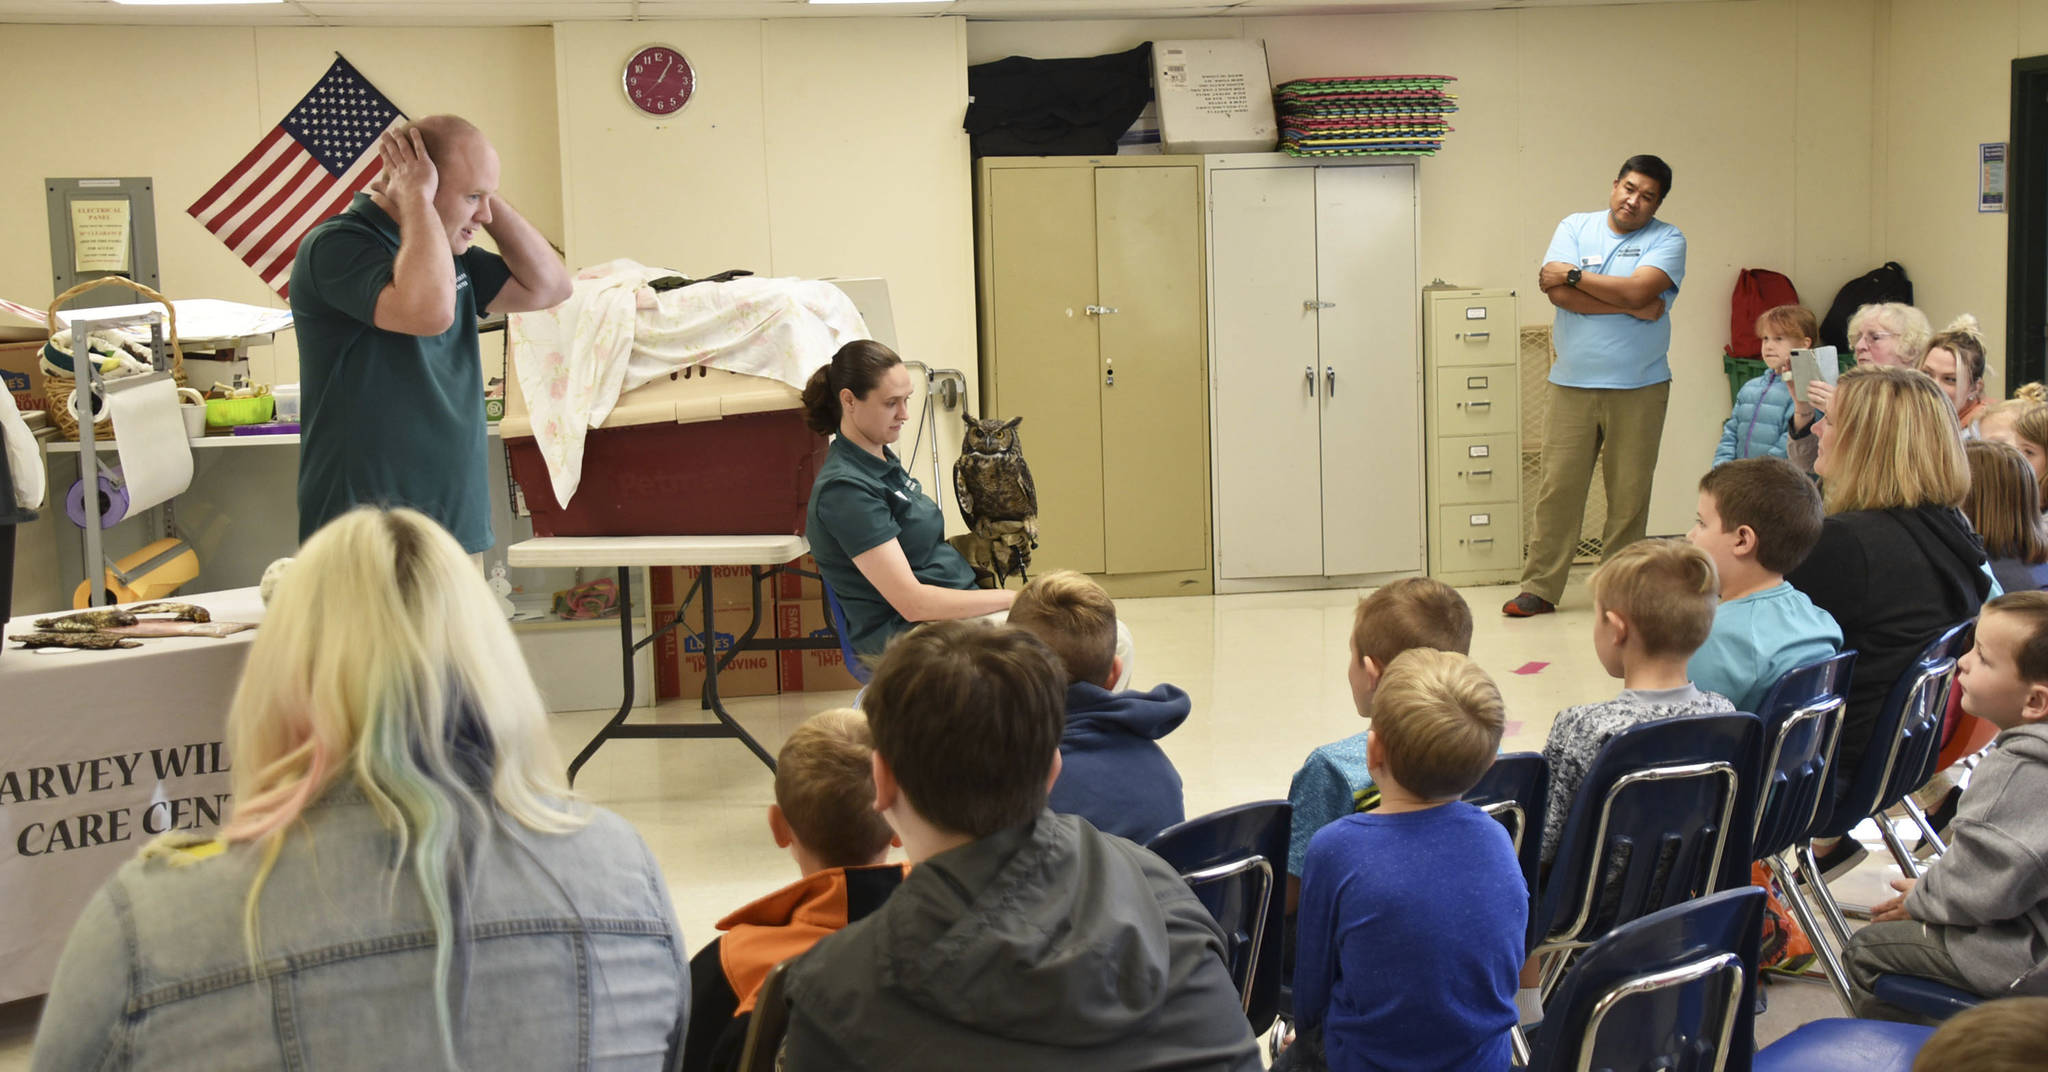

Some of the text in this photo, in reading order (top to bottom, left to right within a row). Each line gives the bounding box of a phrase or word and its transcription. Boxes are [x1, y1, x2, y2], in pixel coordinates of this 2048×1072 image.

[644, 56, 651, 64] 11
[655, 53, 663, 61] 12
[635, 65, 643, 73] 10
[677, 64, 683, 73] 2
[631, 77, 636, 86] 9
[682, 77, 688, 85] 3
[636, 90, 642, 98] 8
[678, 88, 684, 97] 4
[646, 98, 652, 107] 7
[658, 101, 664, 109] 6
[670, 97, 676, 106] 5
[664, 615, 675, 658] SALL
[689, 638, 729, 650] LOE'S
[694, 657, 768, 673] IMOVING
[0, 741, 232, 805] ARVEY WIL
[17, 808, 132, 857] CARE
